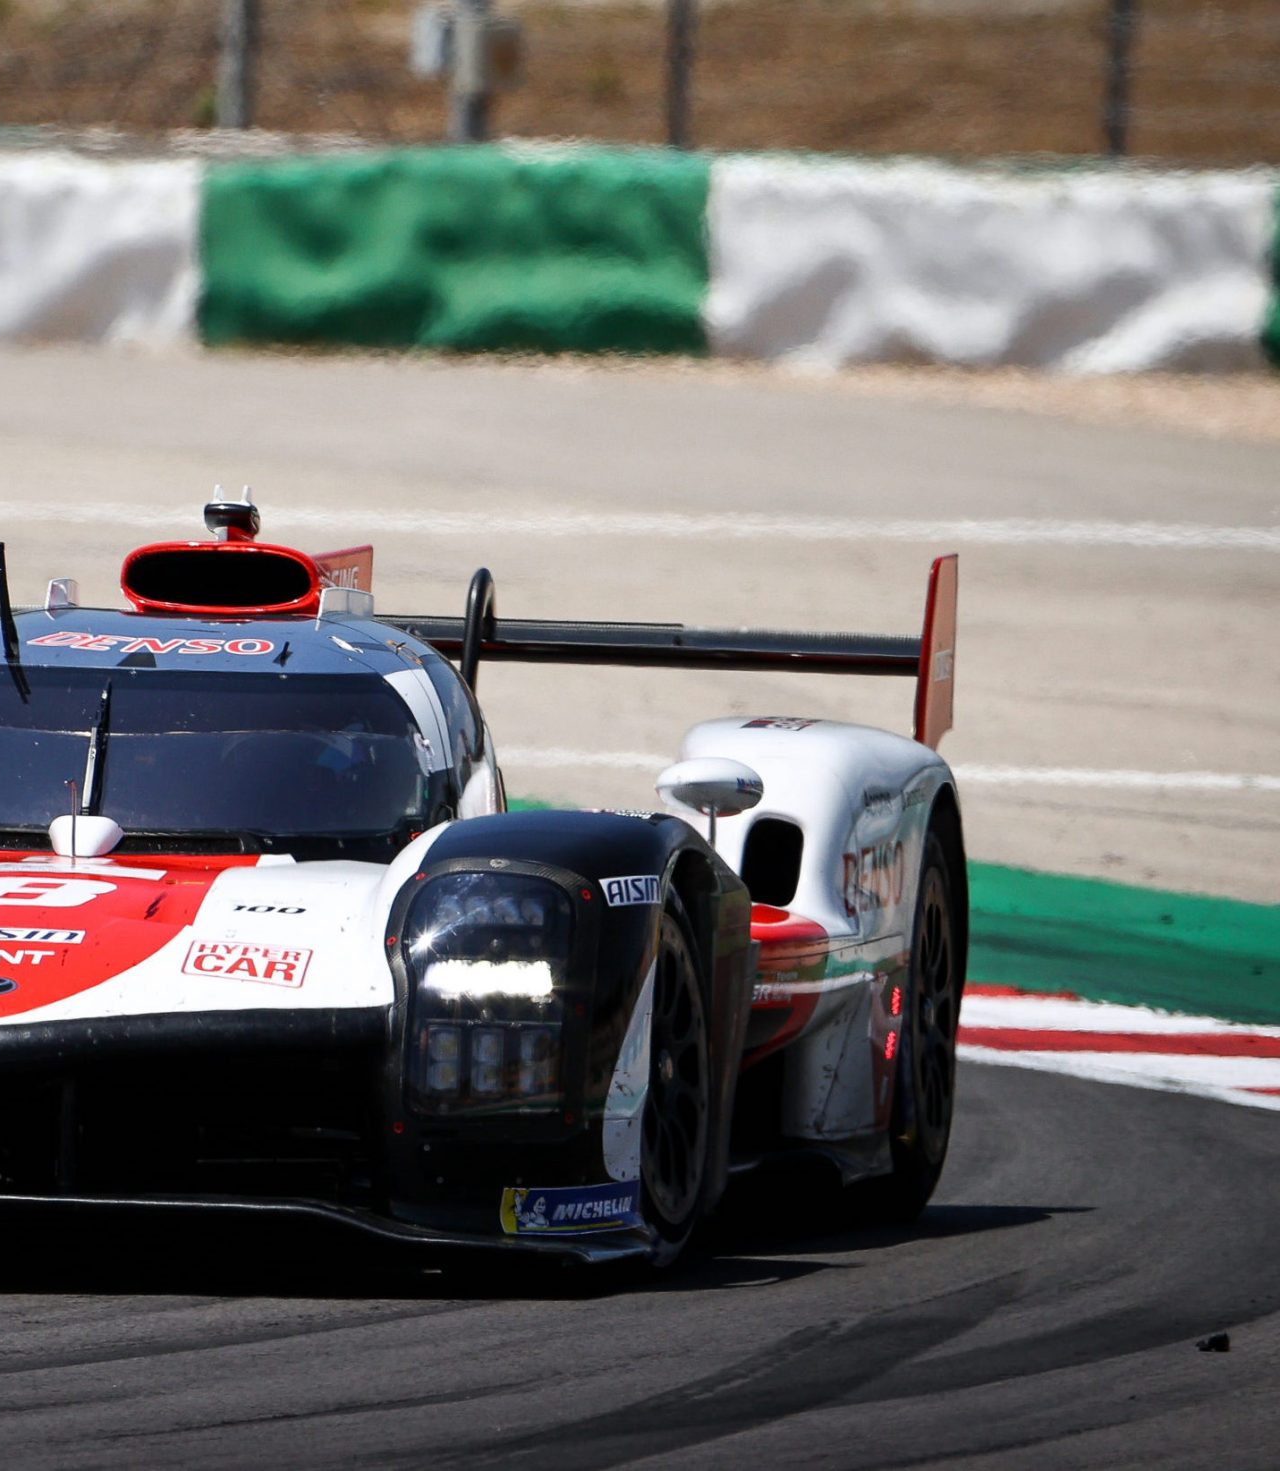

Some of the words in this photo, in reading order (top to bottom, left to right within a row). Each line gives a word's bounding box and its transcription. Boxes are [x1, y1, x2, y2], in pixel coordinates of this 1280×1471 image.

[27, 631, 275, 655] DENSO
[233, 904, 308, 914] 100
[197, 943, 303, 962] HYPER
[192, 953, 298, 982] CAR
[552, 1195, 633, 1221] MICHELIN
